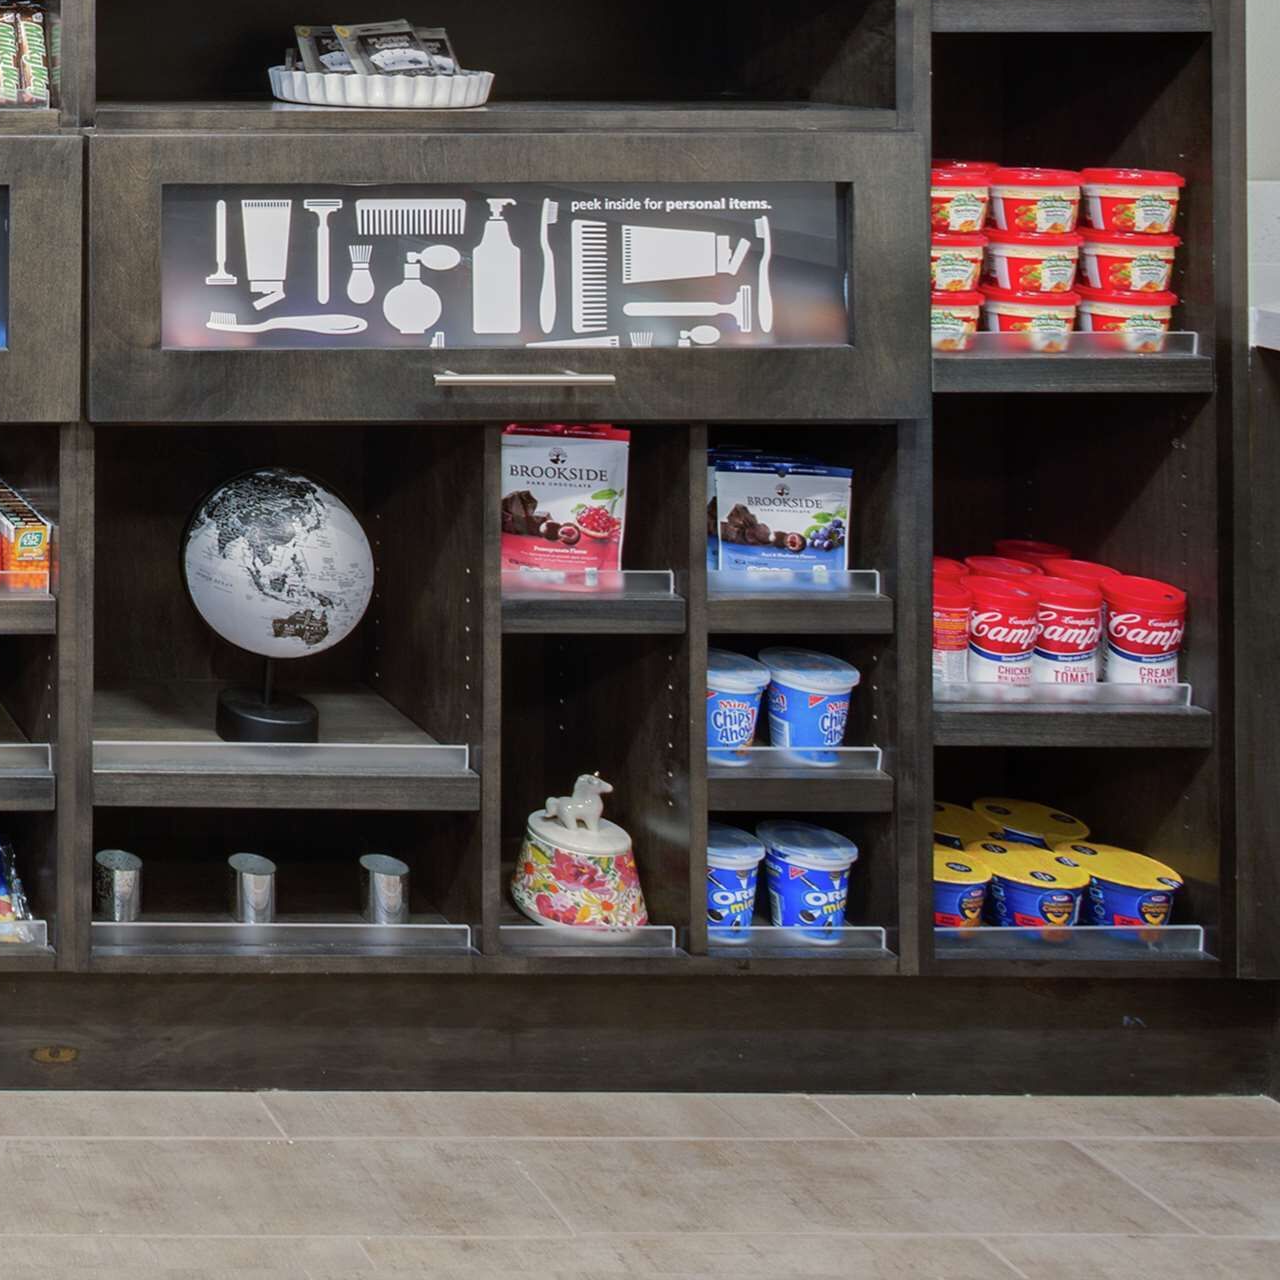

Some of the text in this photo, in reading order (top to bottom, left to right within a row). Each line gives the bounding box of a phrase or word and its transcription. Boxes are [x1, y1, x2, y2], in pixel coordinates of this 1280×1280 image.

[571, 197, 772, 212] peek inside for personal items.
[509, 464, 608, 482] BROOKSIDE
[746, 495, 823, 509] BROOKSIDE
[27, 531, 40, 542] tic
[712, 711, 751, 729] Chips
